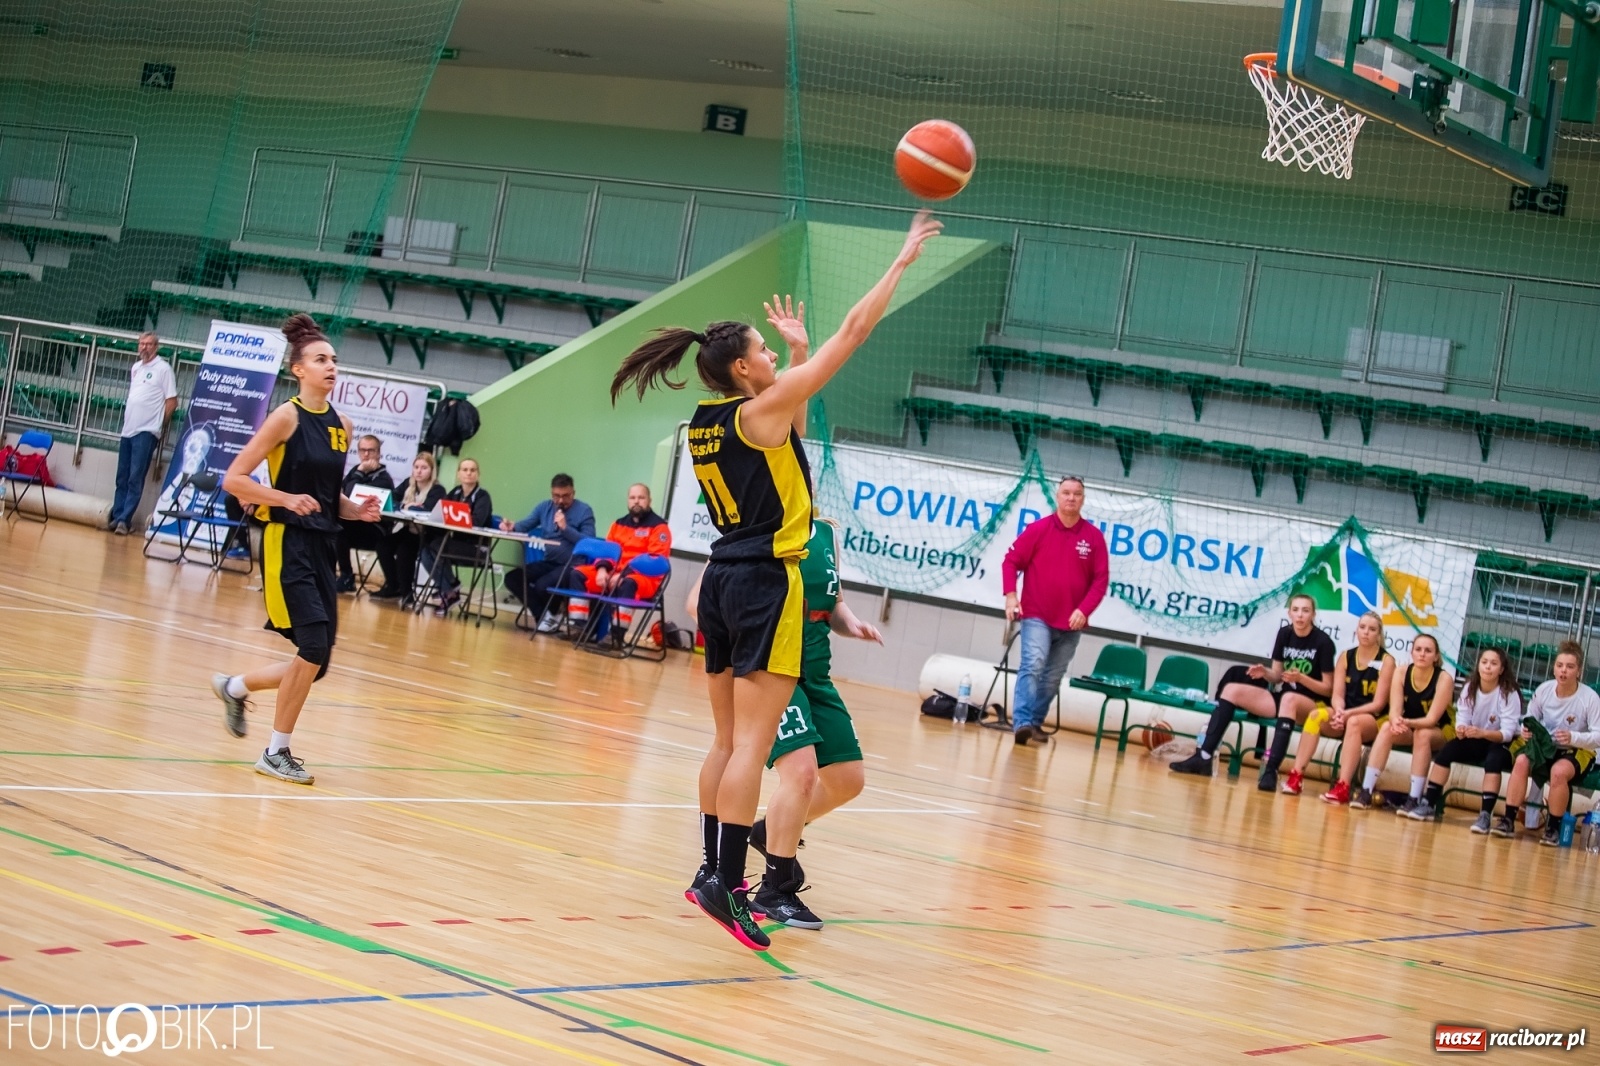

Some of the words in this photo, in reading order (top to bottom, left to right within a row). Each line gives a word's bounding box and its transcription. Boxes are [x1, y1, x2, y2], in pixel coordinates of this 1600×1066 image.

[146, 72, 166, 86] A
[715, 114, 737, 131] B
[1535, 191, 1560, 210] C
[212, 346, 275, 362] ELEKTRONIKA
[200, 369, 221, 384] Duży
[327, 426, 348, 453] 13
[692, 462, 741, 526] 11
[853, 481, 1004, 533] POWIAT
[843, 527, 986, 580] kibicujemy,
[1163, 589, 1259, 628] gramy
[777, 705, 809, 741] 23
